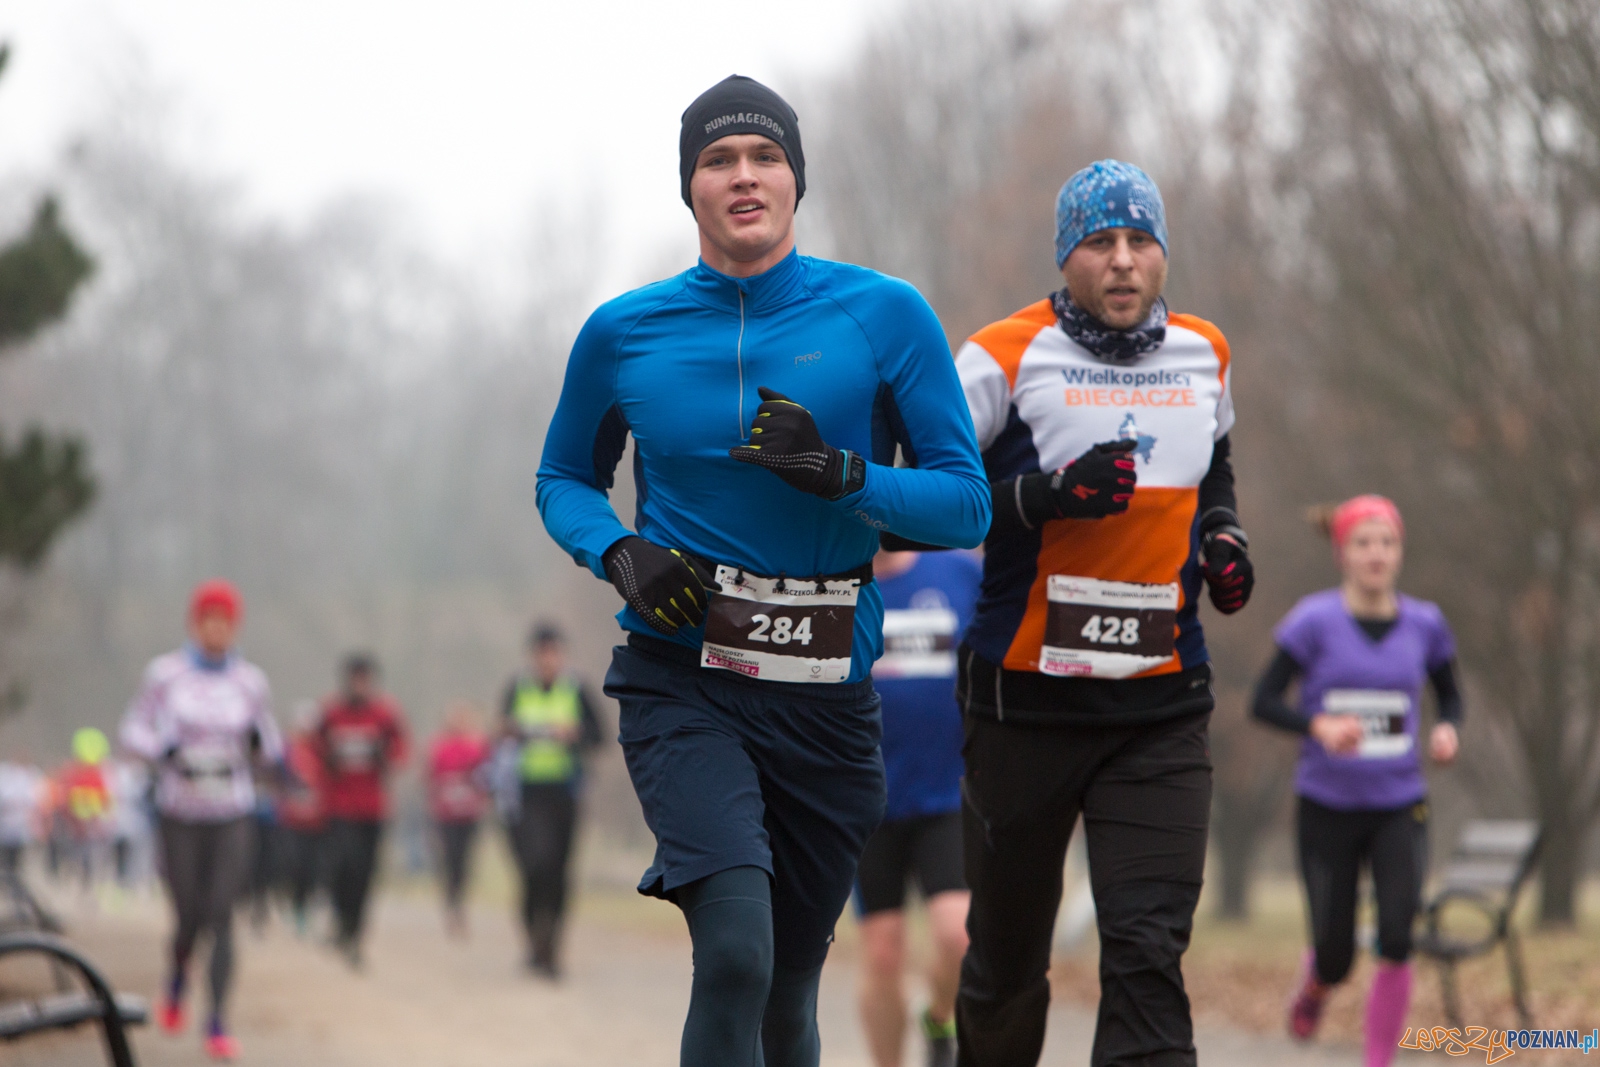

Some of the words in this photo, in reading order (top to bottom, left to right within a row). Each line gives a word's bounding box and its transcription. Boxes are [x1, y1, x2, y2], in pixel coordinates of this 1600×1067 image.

[704, 112, 785, 139] RUNMAGEDDON
[794, 350, 822, 365] PRO
[1061, 368, 1191, 387] Wielkopolscy
[1063, 387, 1198, 407] BIEGACZE
[747, 613, 813, 646] 284
[1080, 614, 1140, 646] 428
[728, 656, 760, 667] POZNANIU
